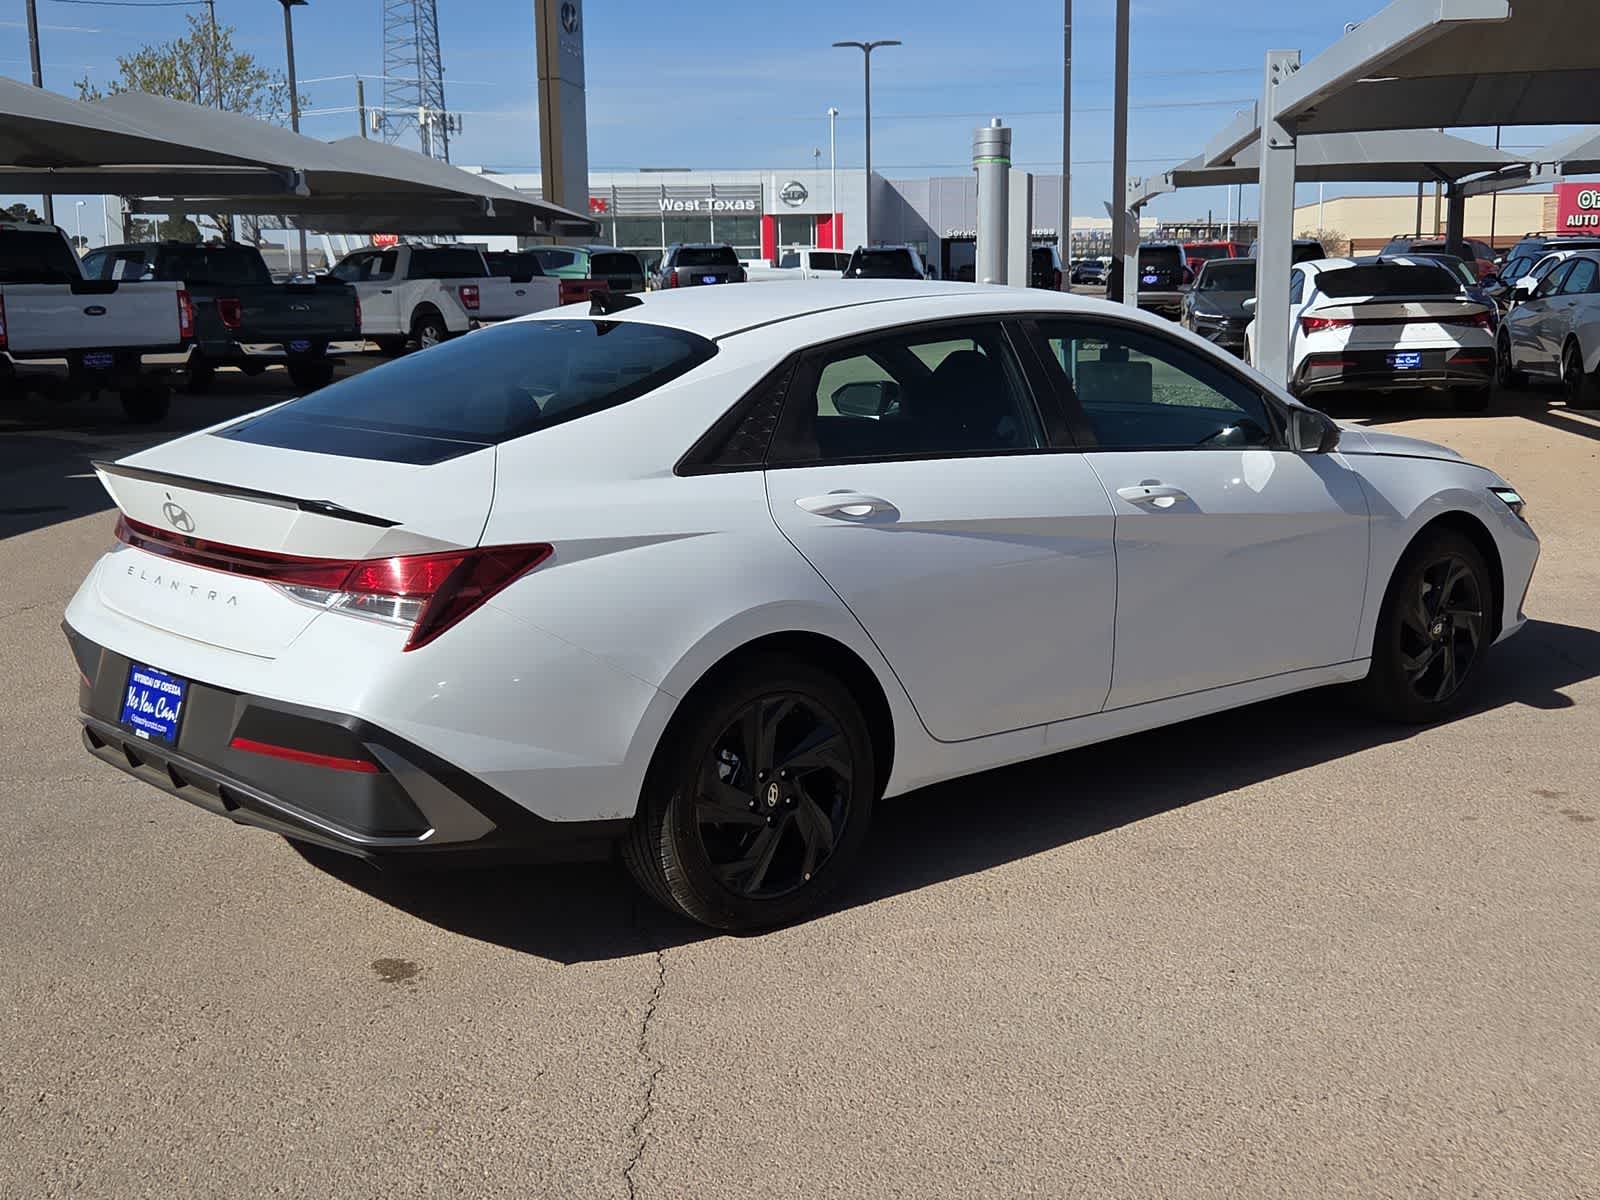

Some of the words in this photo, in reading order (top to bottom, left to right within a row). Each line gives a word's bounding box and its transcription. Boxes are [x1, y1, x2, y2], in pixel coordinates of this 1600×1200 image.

[658, 199, 700, 211] West
[704, 198, 755, 211] Texas
[1566, 214, 1599, 226] AUTO
[946, 229, 977, 237] Servic
[127, 565, 238, 606] ELANTRA
[126, 686, 138, 709] Yes
[138, 690, 154, 713] You
[155, 697, 182, 723] Can!
